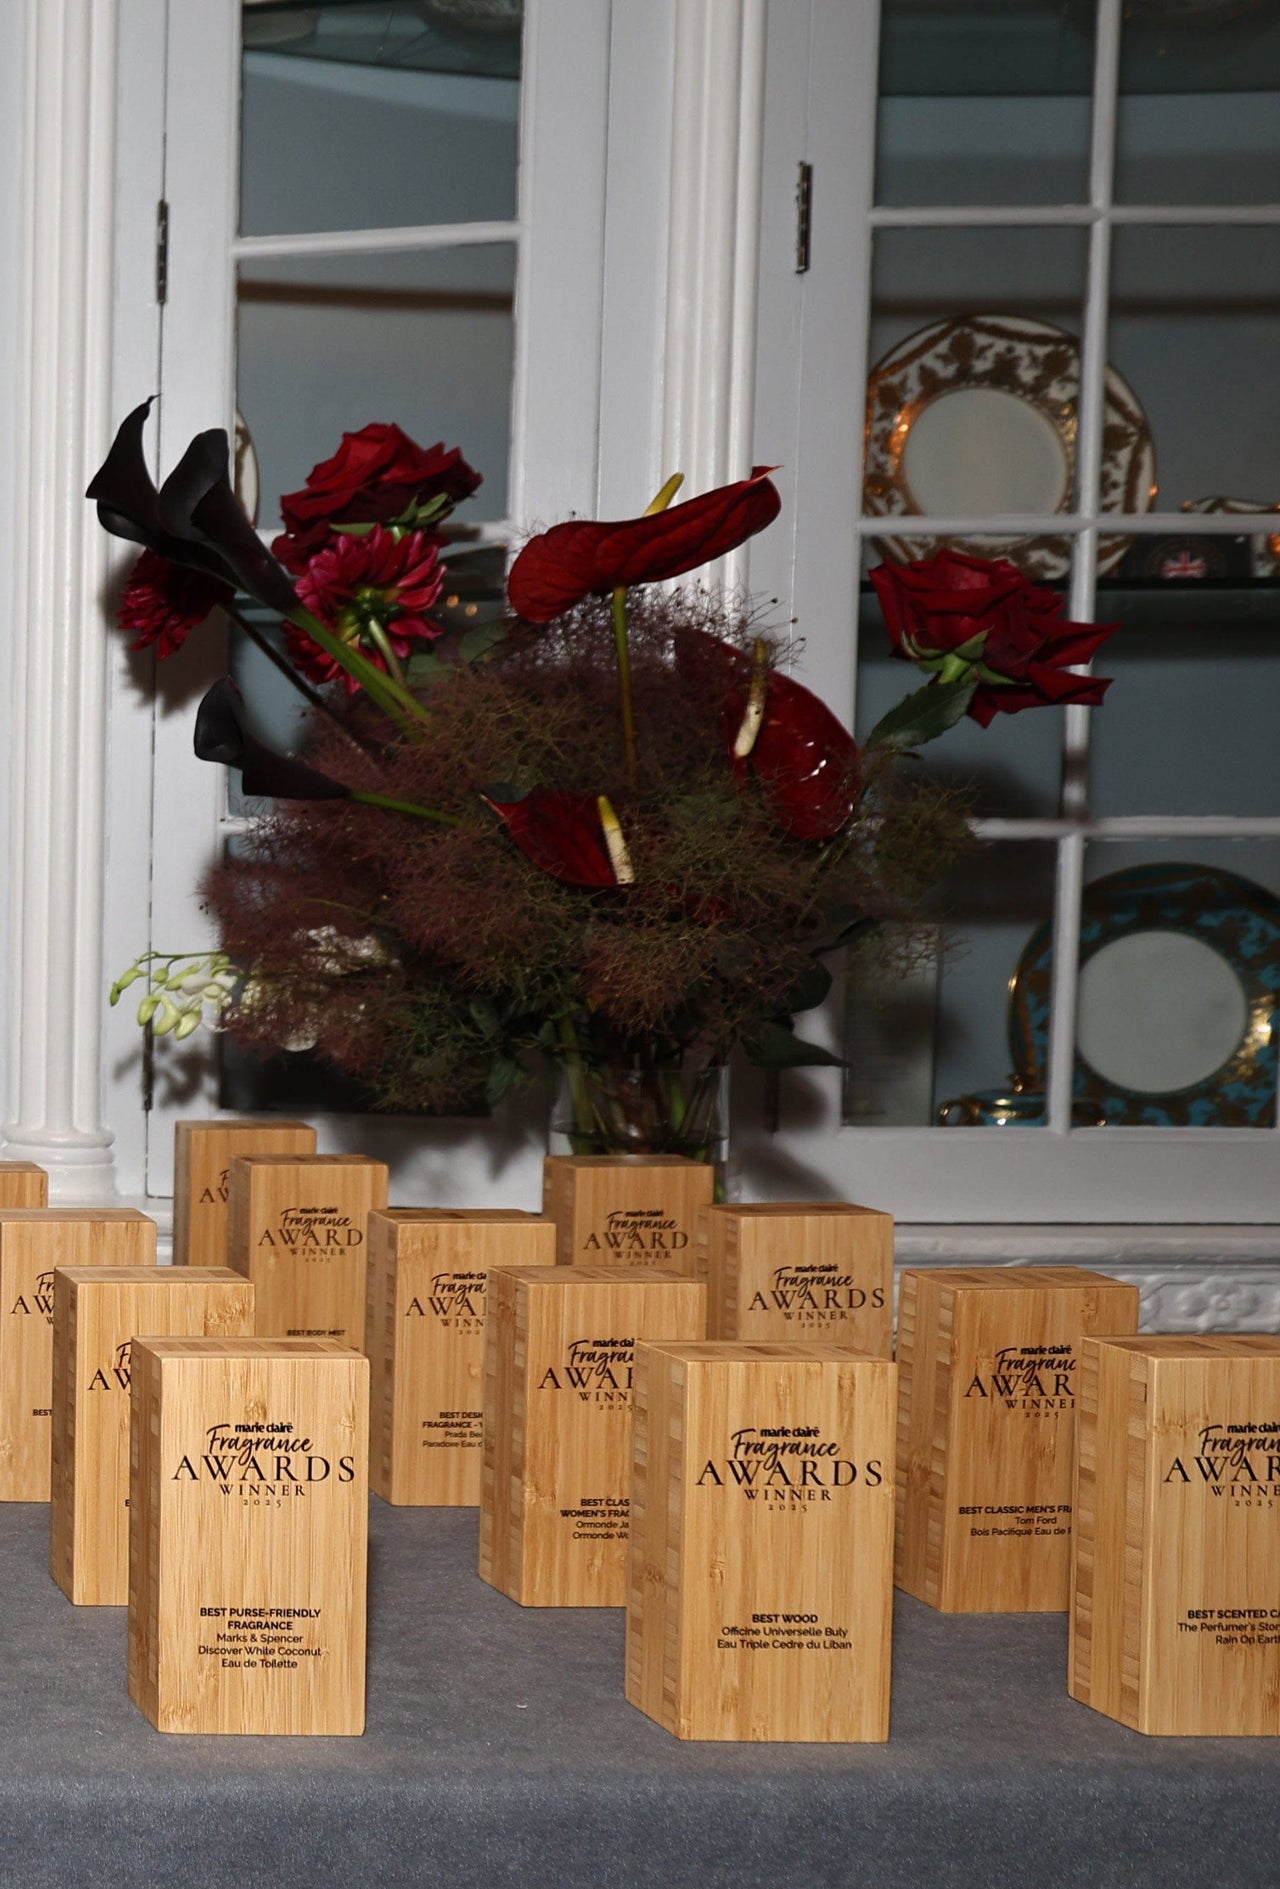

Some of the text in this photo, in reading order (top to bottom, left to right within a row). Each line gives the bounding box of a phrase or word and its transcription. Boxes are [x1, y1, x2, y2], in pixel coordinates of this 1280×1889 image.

[281, 1208, 351, 1235] Fragrance
[607, 1211, 678, 1238] Fragrance
[290, 1248, 346, 1256] WINNER
[774, 1266, 853, 1297] Fragrance
[748, 1288, 884, 1310] AWARDS
[784, 1311, 847, 1320] WINNER
[206, 1424, 313, 1465] Fragrance
[731, 1429, 840, 1470] Fragrance
[172, 1456, 355, 1482] AWARDS
[696, 1461, 882, 1486] AWARDS
[220, 1484, 305, 1496] WINNER
[744, 1489, 832, 1501] WINNER
[244, 1500, 282, 1508] 2025
[768, 1504, 807, 1512] 2025
[985, 1506, 1024, 1514] CLASSIC
[971, 1528, 990, 1536] Bois
[992, 1528, 1032, 1538] Pacifique
[200, 1608, 321, 1618] BEST PURSE-FRIENDLY
[1188, 1610, 1267, 1619] BEST SCENTED
[752, 1614, 818, 1623] BEST WOOD
[228, 1621, 292, 1629] FRAGRANCE
[1178, 1623, 1255, 1633] The Perfumer's
[722, 1627, 848, 1638] Officine Universelle Buly
[217, 1634, 303, 1645] Marks & Spencer
[1216, 1636, 1255, 1644] Rain On
[717, 1640, 736, 1648] Eau
[740, 1640, 769, 1650] Triple
[807, 1640, 820, 1649] du
[824, 1640, 852, 1649] Liban
[198, 1646, 321, 1656] Discover White Coconut
[222, 1659, 297, 1668] Eau de Toilette
